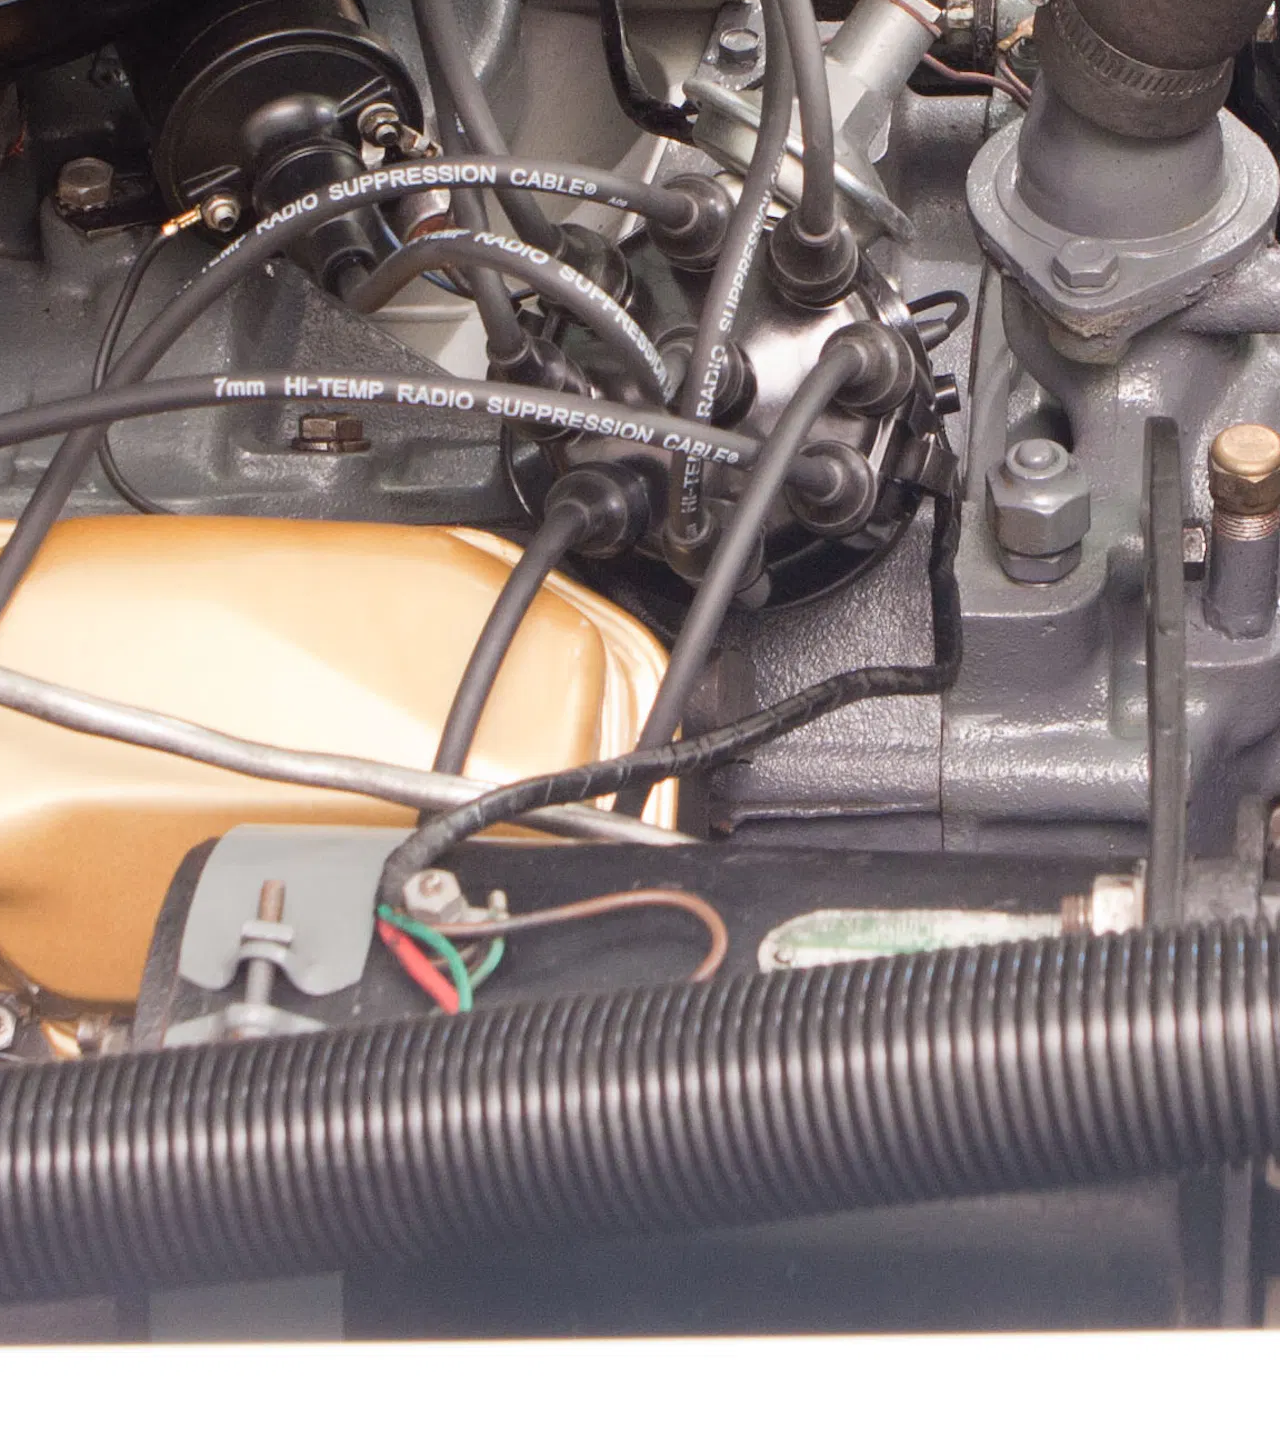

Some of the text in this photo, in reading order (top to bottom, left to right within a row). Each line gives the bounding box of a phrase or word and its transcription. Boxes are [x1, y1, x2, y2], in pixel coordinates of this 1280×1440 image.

[328, 165, 497, 201] SUPPRESSION
[473, 231, 550, 265] RADIO
[696, 344, 727, 419] RADIO
[718, 189, 772, 333] SUPPRESSION
[214, 377, 265, 398] 7mm
[283, 376, 384, 400] HI-TEMP
[397, 383, 474, 410] RADIO
[487, 395, 654, 444] SUPPRESSION
